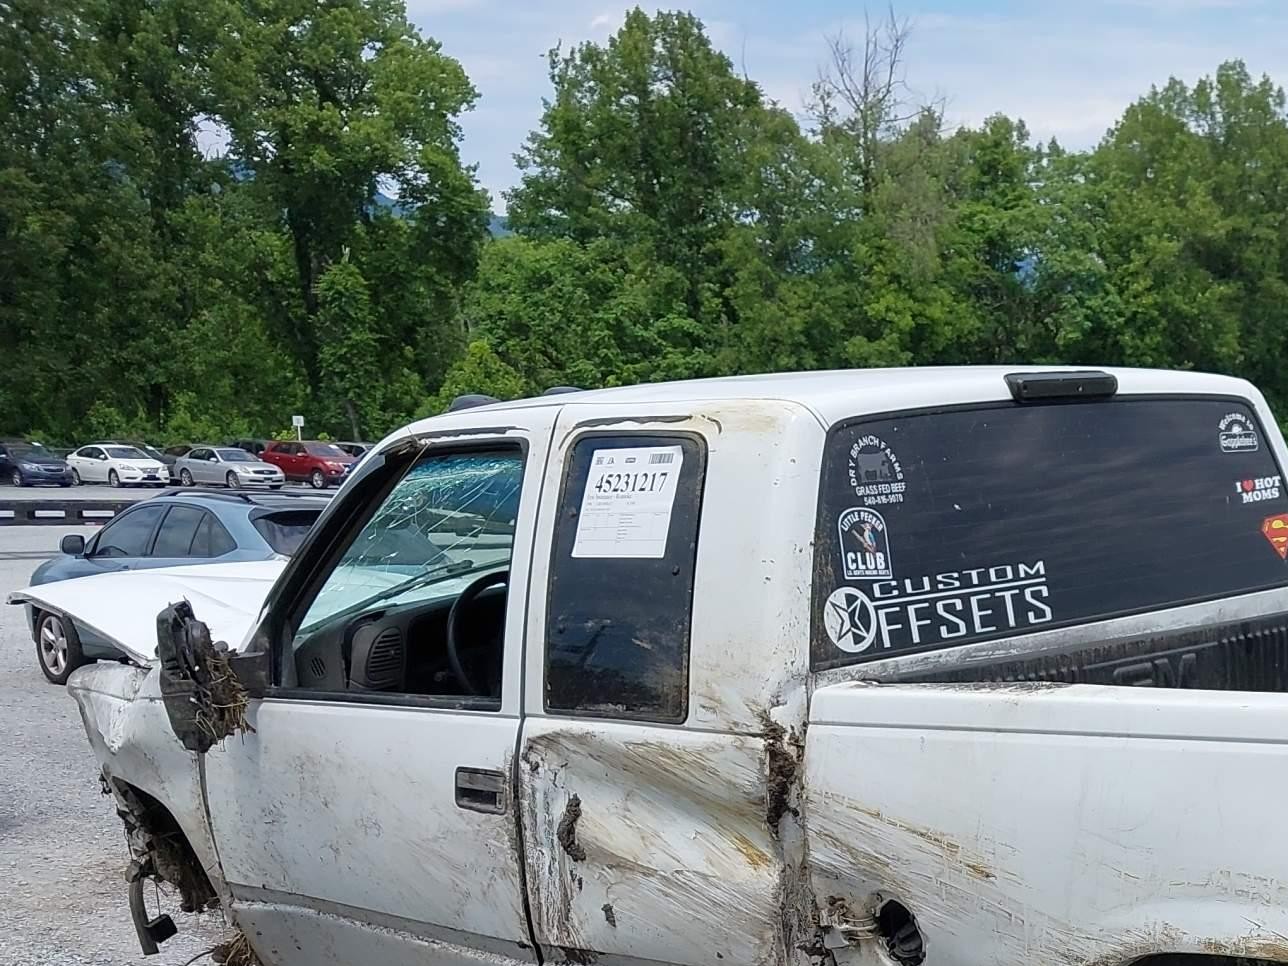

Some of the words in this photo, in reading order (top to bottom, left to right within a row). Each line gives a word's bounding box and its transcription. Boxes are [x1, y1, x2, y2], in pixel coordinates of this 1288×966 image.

[850, 435, 880, 459] BRANCH
[880, 441, 904, 480] FARMS
[595, 471, 669, 493] 45231217
[848, 459, 858, 486] DRY
[855, 485, 878, 496] GRASS
[878, 484, 891, 494] FED
[891, 482, 906, 493] BEEF
[1236, 482, 1243, 493] I
[1255, 476, 1281, 491] HOT
[1241, 488, 1280, 504] MOMS
[841, 512, 860, 532] LITTLE
[846, 552, 885, 570] CLUB
[872, 560, 1047, 598] CUSTOM
